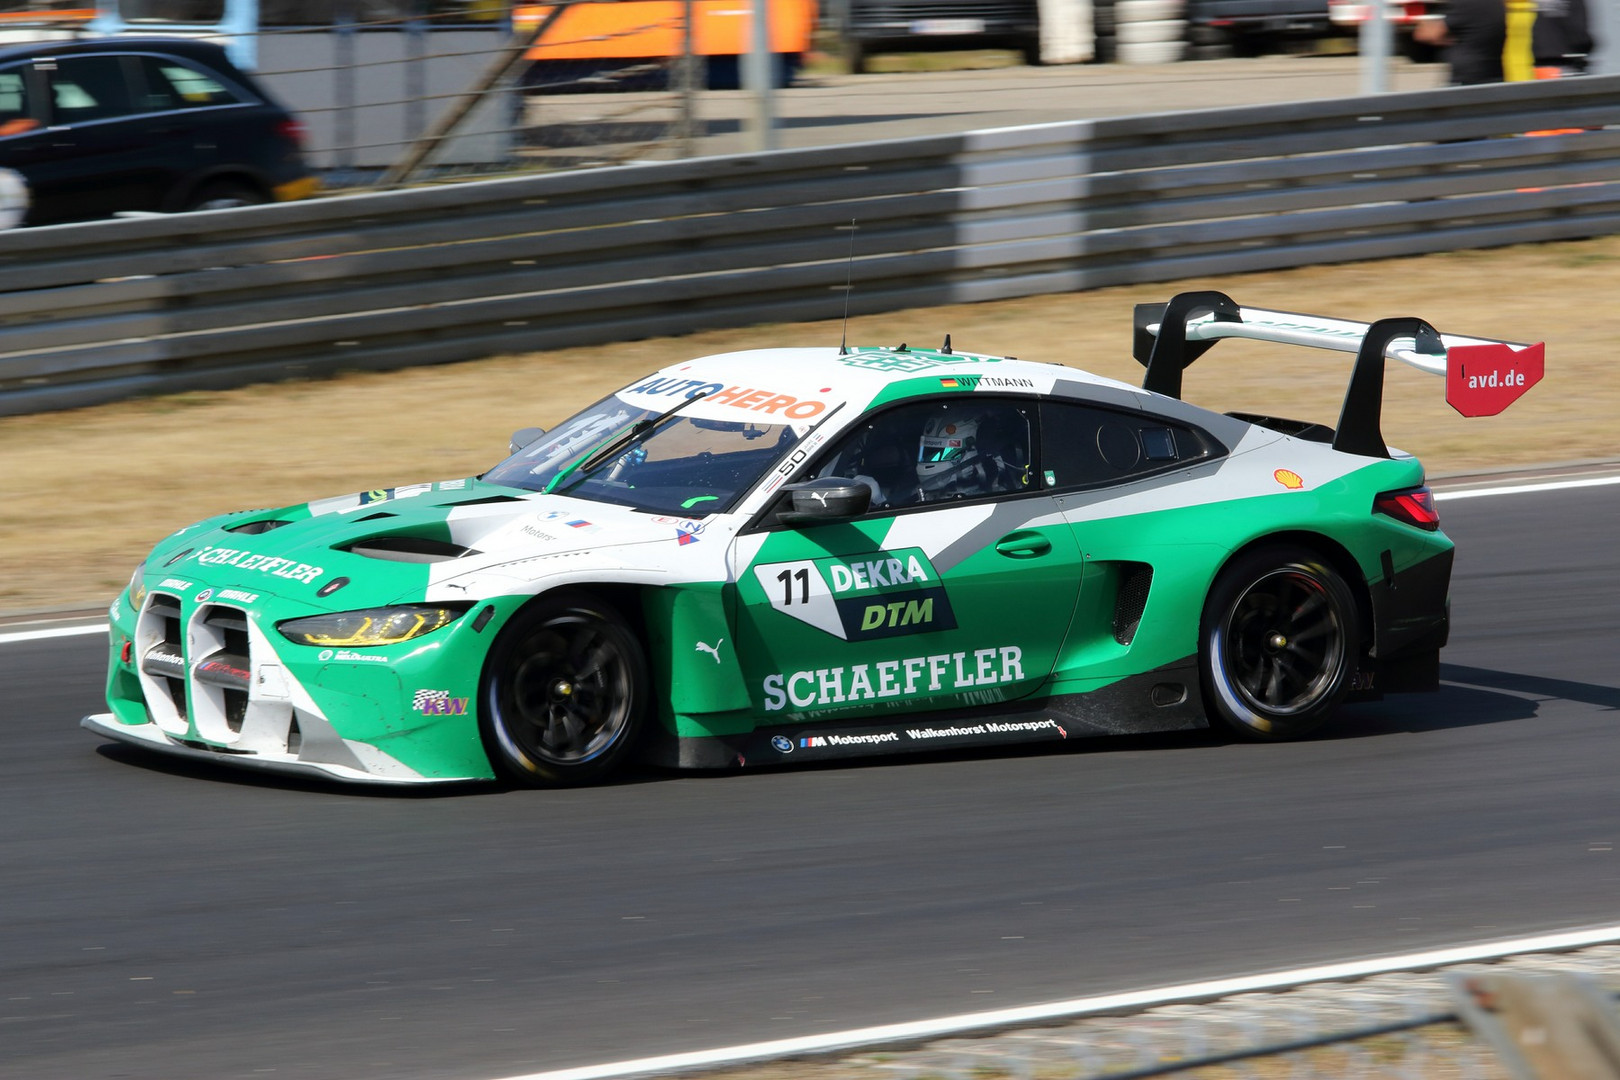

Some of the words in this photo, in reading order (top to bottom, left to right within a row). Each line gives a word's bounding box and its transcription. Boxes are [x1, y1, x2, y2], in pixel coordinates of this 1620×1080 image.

[958, 377, 1034, 388] WITTMANN
[1469, 369, 1525, 389] avd.de
[779, 449, 807, 476] 50
[829, 555, 929, 594] DEKRA
[216, 589, 260, 604] MAHLE
[776, 568, 810, 607] 11
[861, 598, 934, 631] DTM
[763, 645, 1025, 711] SCHAEFFLER
[422, 697, 469, 716] KW
[828, 731, 899, 746] Motorsport
[905, 723, 987, 741] Walkenhorst
[988, 718, 1058, 734] Motorsport
